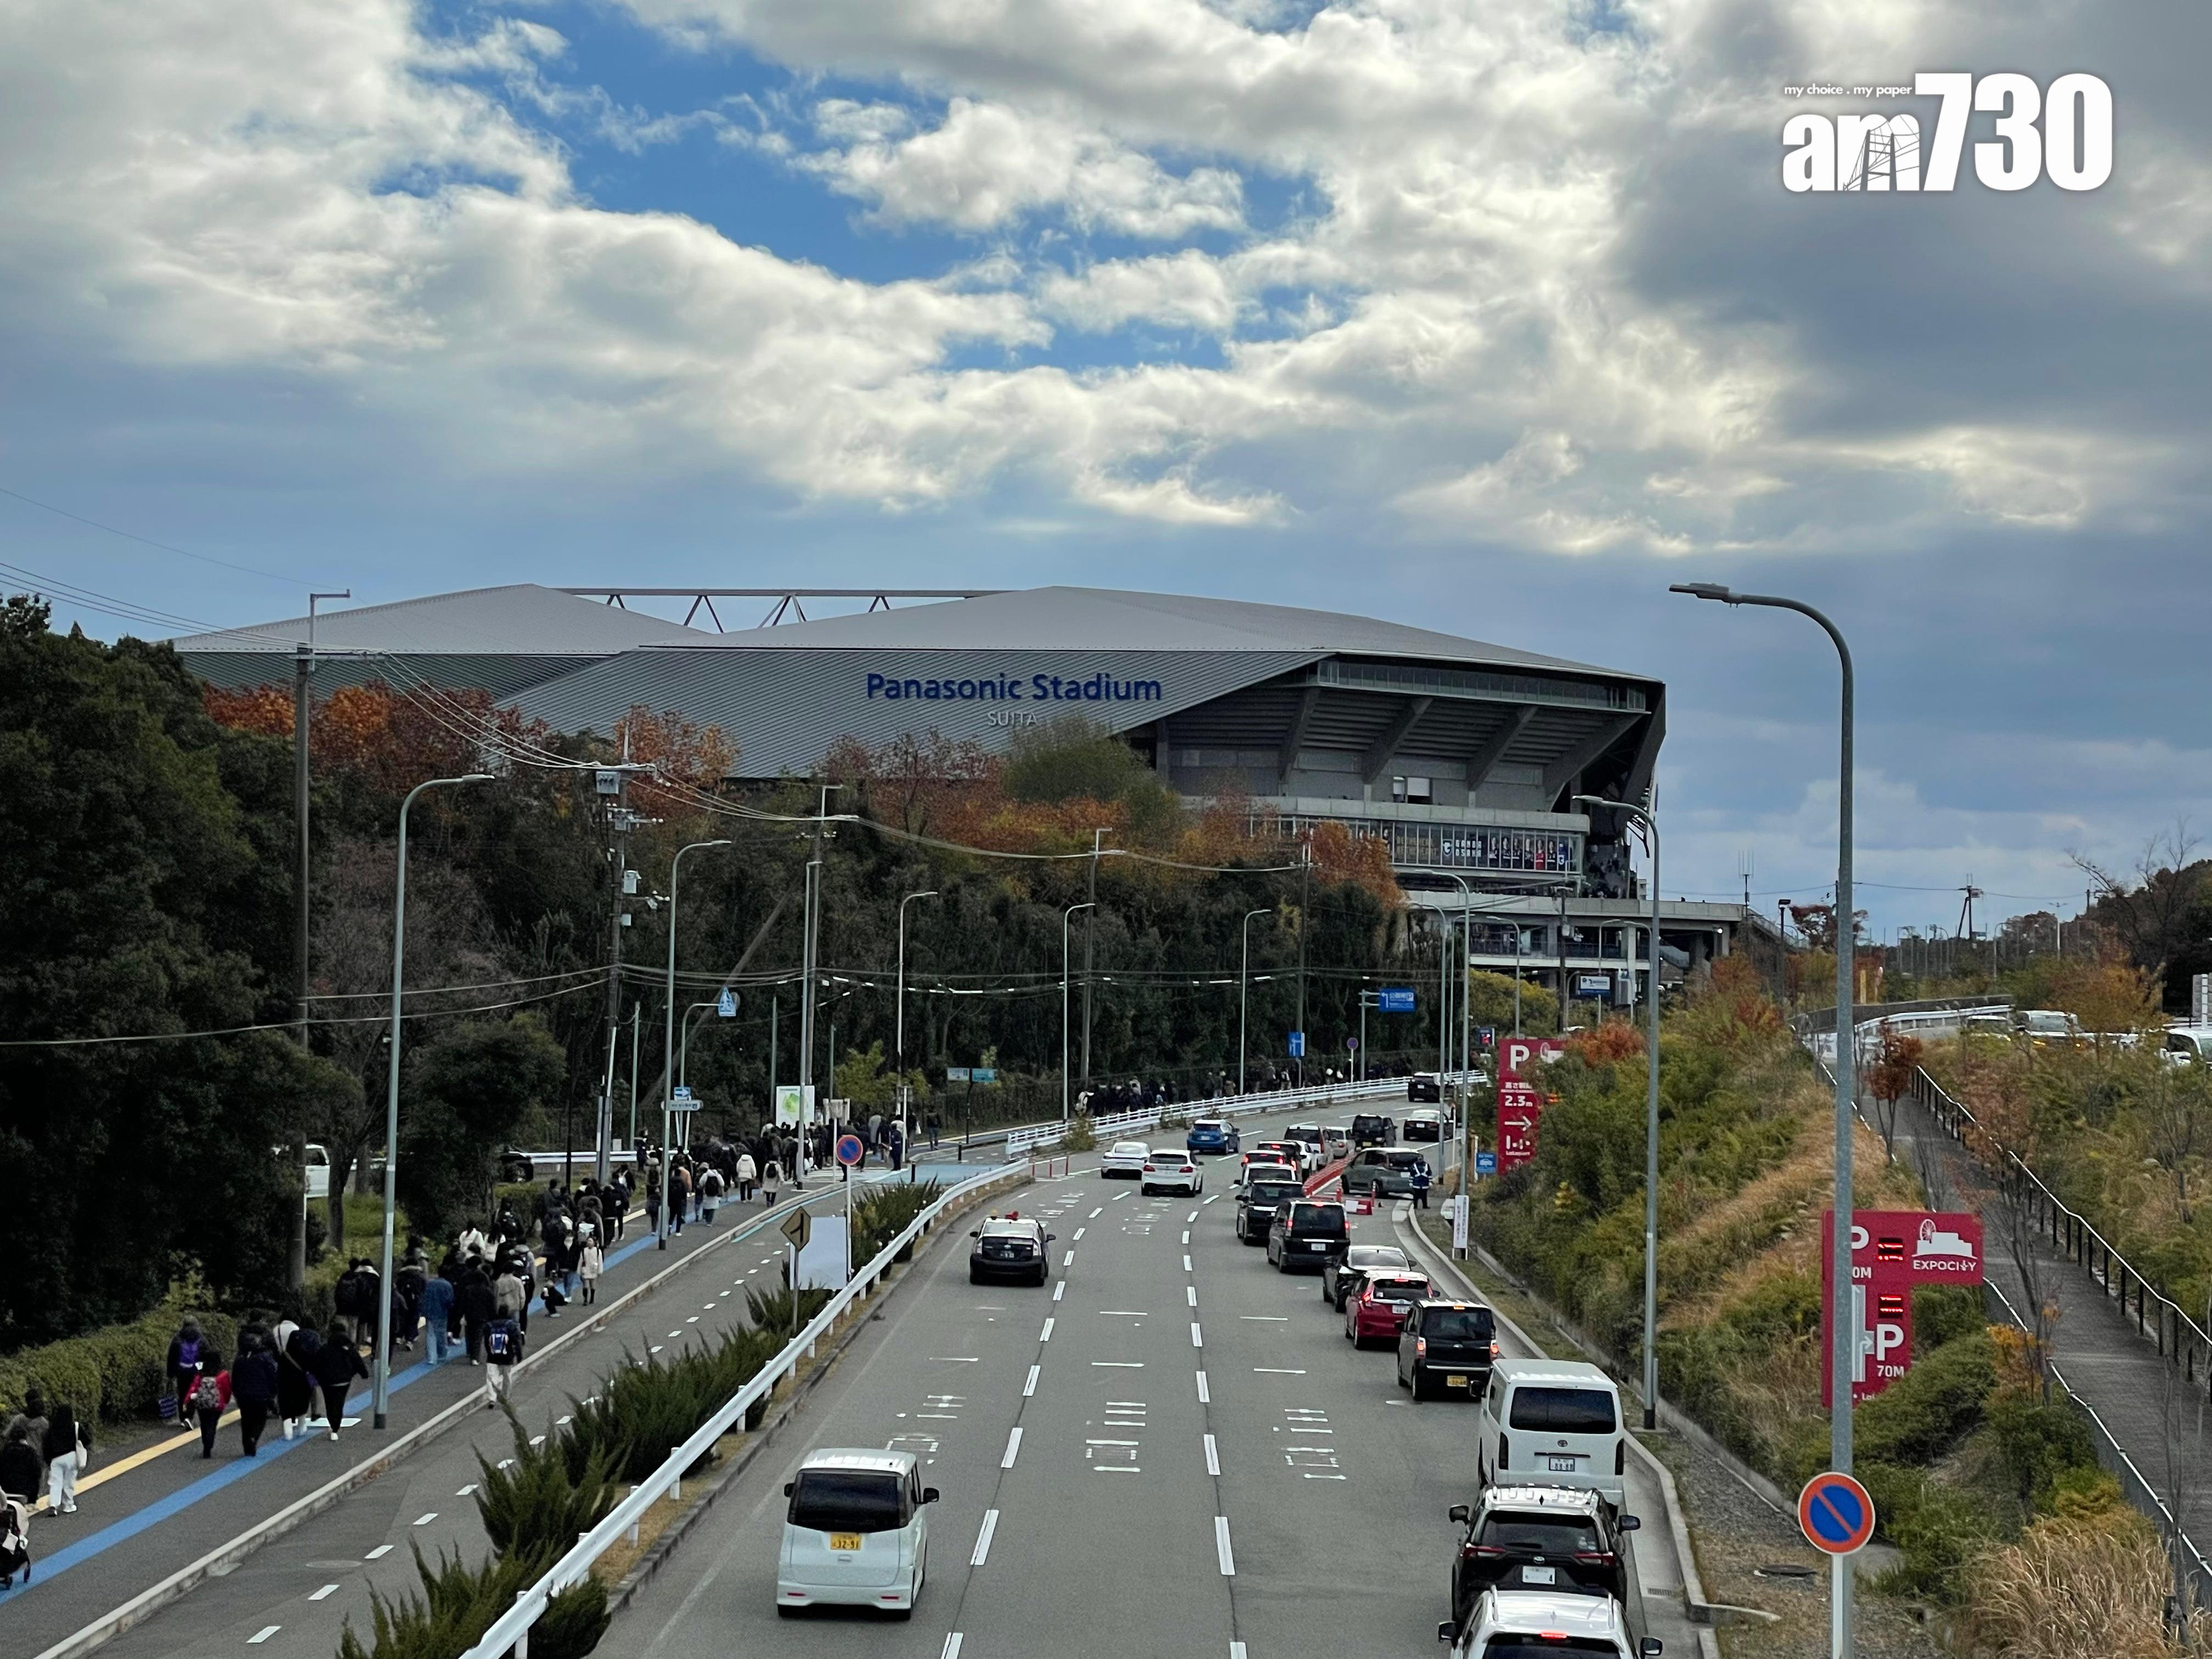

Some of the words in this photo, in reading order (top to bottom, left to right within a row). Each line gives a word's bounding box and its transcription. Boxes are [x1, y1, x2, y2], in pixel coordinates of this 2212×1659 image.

[866, 673, 1022, 700] Panasonic
[1032, 673, 1161, 701] Stadium
[988, 712, 1038, 726] SUITA
[1510, 1045, 1530, 1070] P
[1505, 1095, 1533, 1107] 2.3m
[1876, 1324, 1904, 1361] P
[1877, 1365, 1904, 1378] 70M
